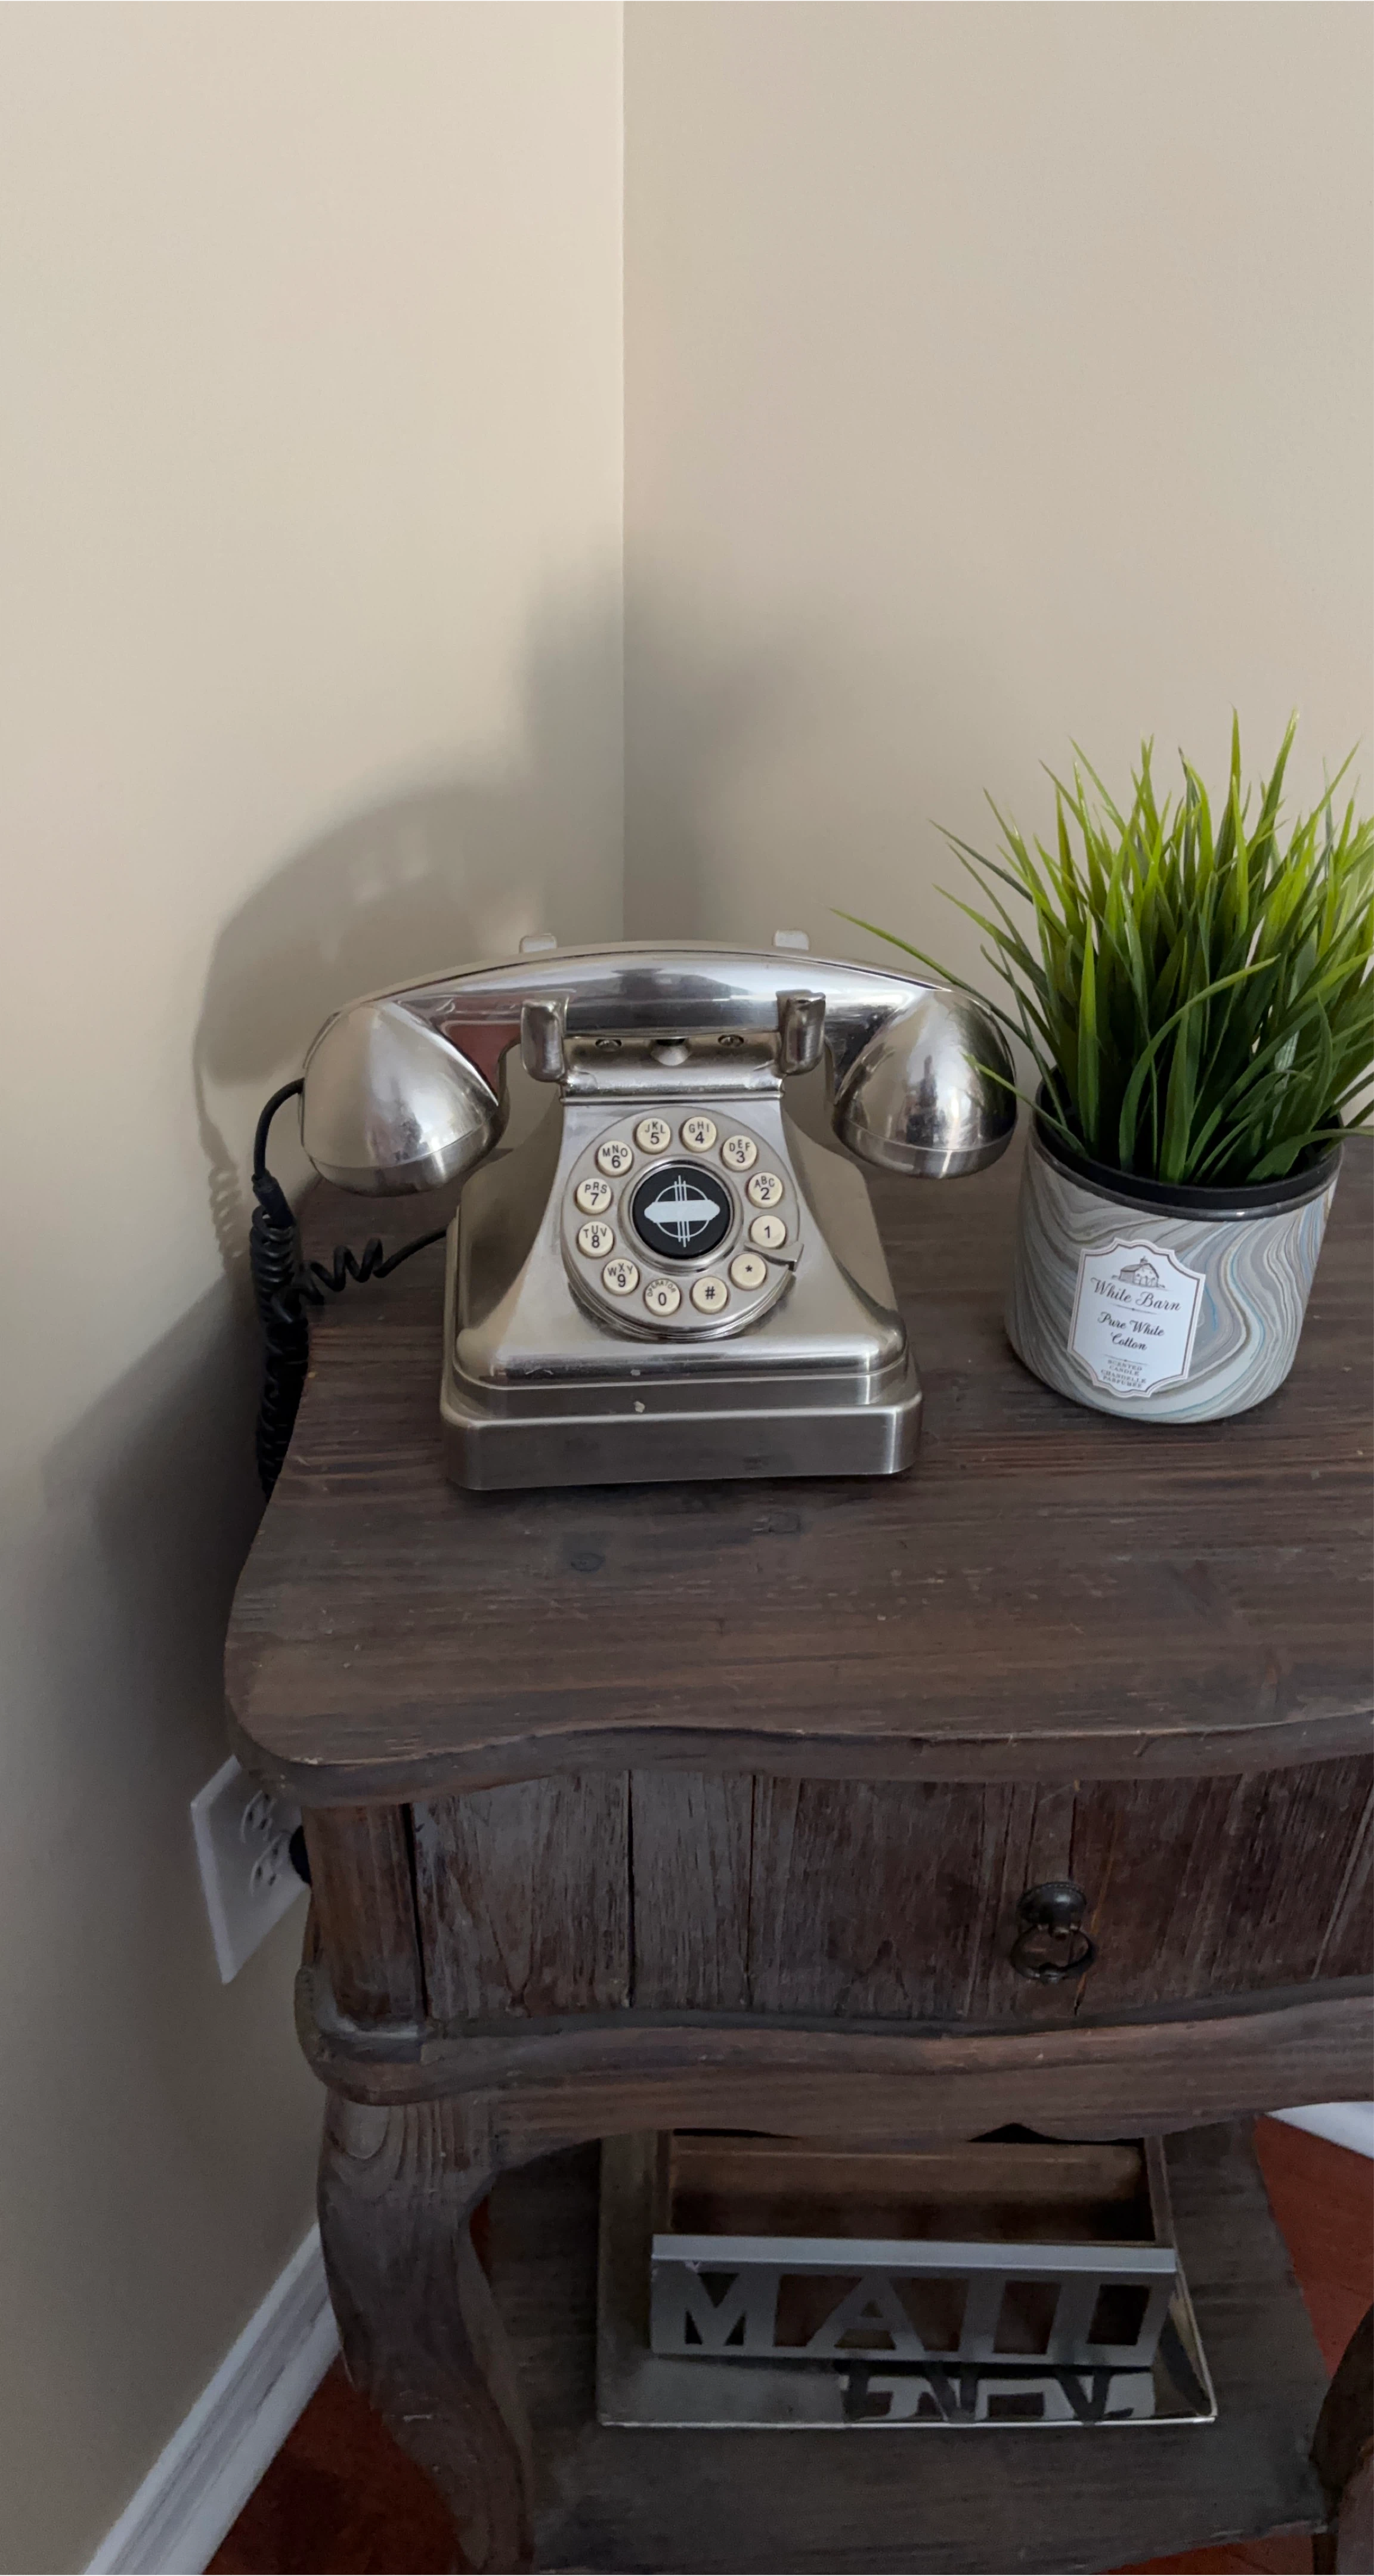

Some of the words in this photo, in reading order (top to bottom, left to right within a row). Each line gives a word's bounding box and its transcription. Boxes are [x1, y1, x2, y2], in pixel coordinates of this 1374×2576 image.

[645, 1121, 666, 1134] JKL
[689, 1121, 710, 1133] GHI
[650, 1132, 660, 1145] 5
[695, 1132, 704, 1144] 4
[603, 1144, 628, 1157] MNO
[729, 1139, 751, 1152] DEF
[611, 1155, 621, 1169] 6
[736, 1150, 745, 1163] 3
[585, 1182, 608, 1194] PRS
[754, 1176, 775, 1188] ABC
[590, 1193, 599, 1206] 7
[761, 1188, 770, 1200] 2
[583, 1225, 607, 1238] TUV
[764, 1225, 771, 1239] 1
[592, 1235, 600, 1248] 8
[607, 1263, 633, 1277] WXY
[617, 1274, 626, 1288] 9
[1090, 1277, 1132, 1303] White
[1135, 1291, 1182, 1311] Barn
[1097, 1311, 1127, 1330] Pure
[1129, 1319, 1165, 1336] White
[1110, 1332, 1147, 1351] Cotton
[653, 2267, 1157, 2363] MAIL
